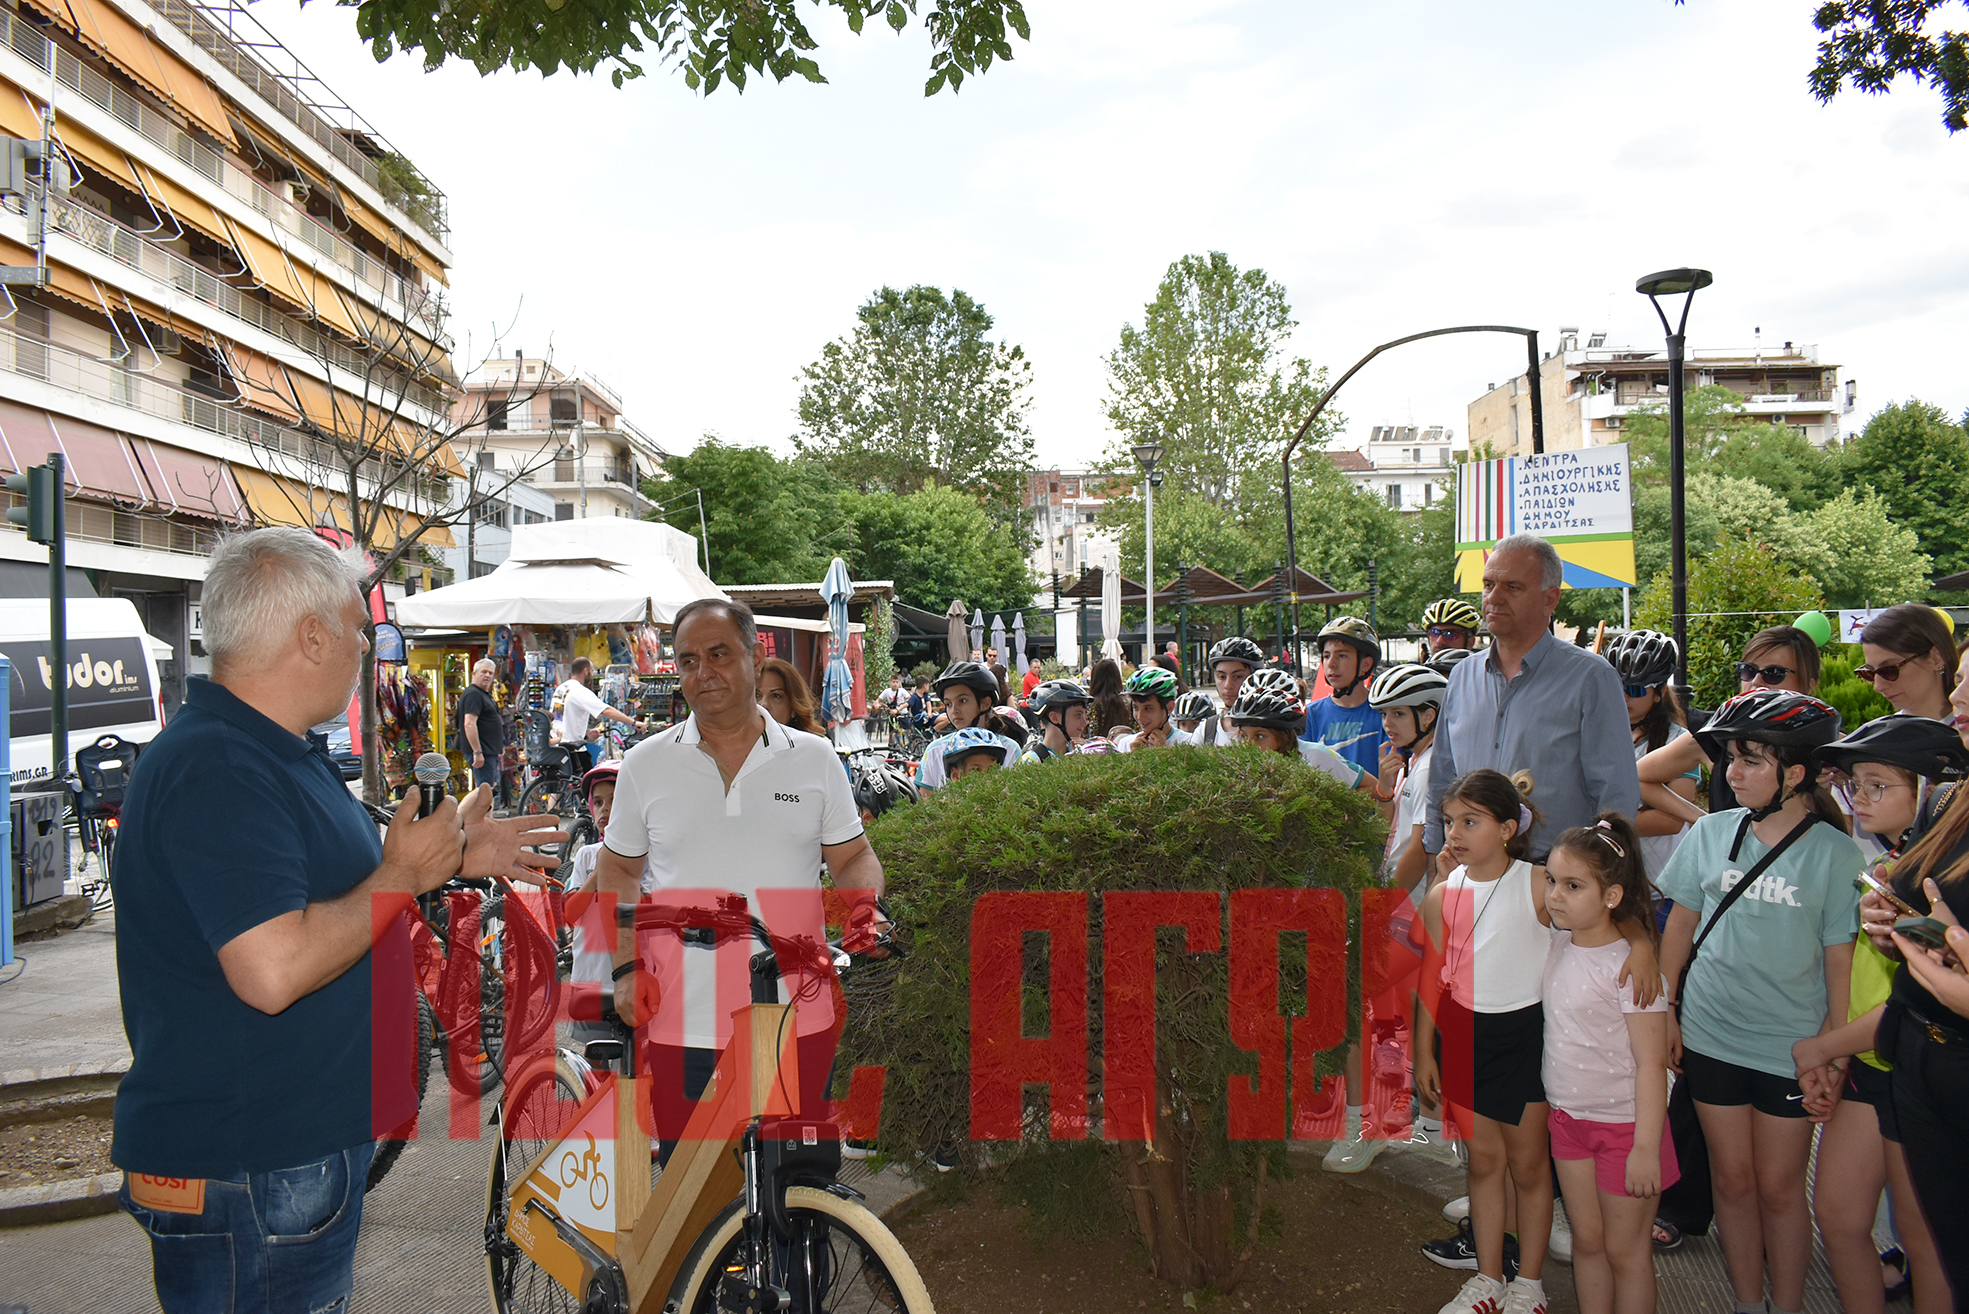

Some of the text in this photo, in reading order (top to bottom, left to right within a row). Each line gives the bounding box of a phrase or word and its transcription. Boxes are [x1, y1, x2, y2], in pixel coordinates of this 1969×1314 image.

[1523, 453, 1578, 470] ΚΕΝΤΡΑ
[1523, 462, 1622, 485] ΔΗΜΙΟΥΡΓΙΚΗΣ
[1523, 479, 1621, 497] ΑΠΑΣΧΟΛΗΣΗΣ
[1524, 496, 1575, 510] ΠΑΙΔΙΩΝ
[1523, 510, 1571, 521] ΔΗΜΟΥ
[1524, 518, 1595, 531] ΚΑΡΔΙΤΣΑΣ
[109, 685, 140, 694] aluminium
[774, 792, 800, 803] BOSS
